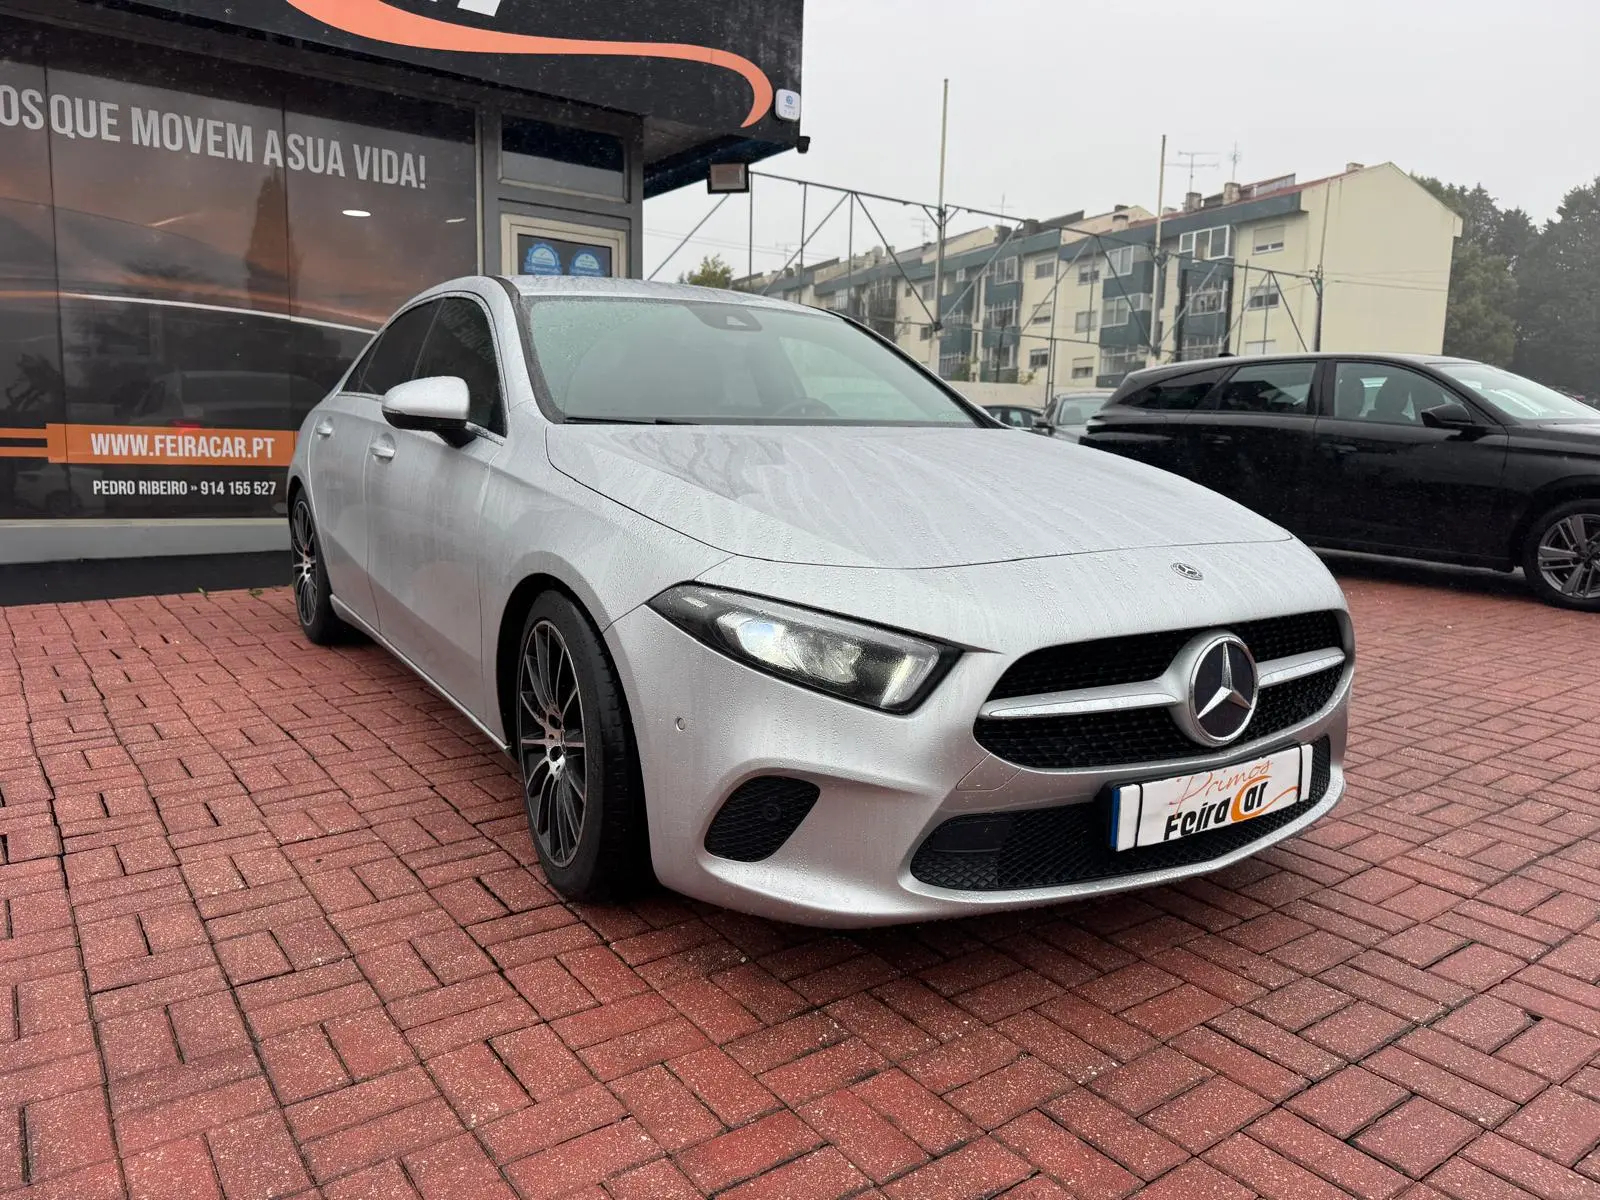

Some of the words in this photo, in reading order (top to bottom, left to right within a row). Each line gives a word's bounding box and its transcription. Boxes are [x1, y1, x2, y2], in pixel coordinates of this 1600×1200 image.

[50, 94, 120, 143] QUE
[131, 106, 253, 163] MOVEM
[263, 130, 284, 168] A
[287, 133, 346, 178] SUA
[353, 144, 427, 189] VIDA!
[90, 433, 275, 458] WWW.FEIRACAR.PT
[93, 480, 135, 496] PEDRO
[139, 480, 188, 496] RIBEIRO
[200, 481, 225, 496] 914
[229, 481, 250, 496] 155
[254, 481, 277, 496] 527
